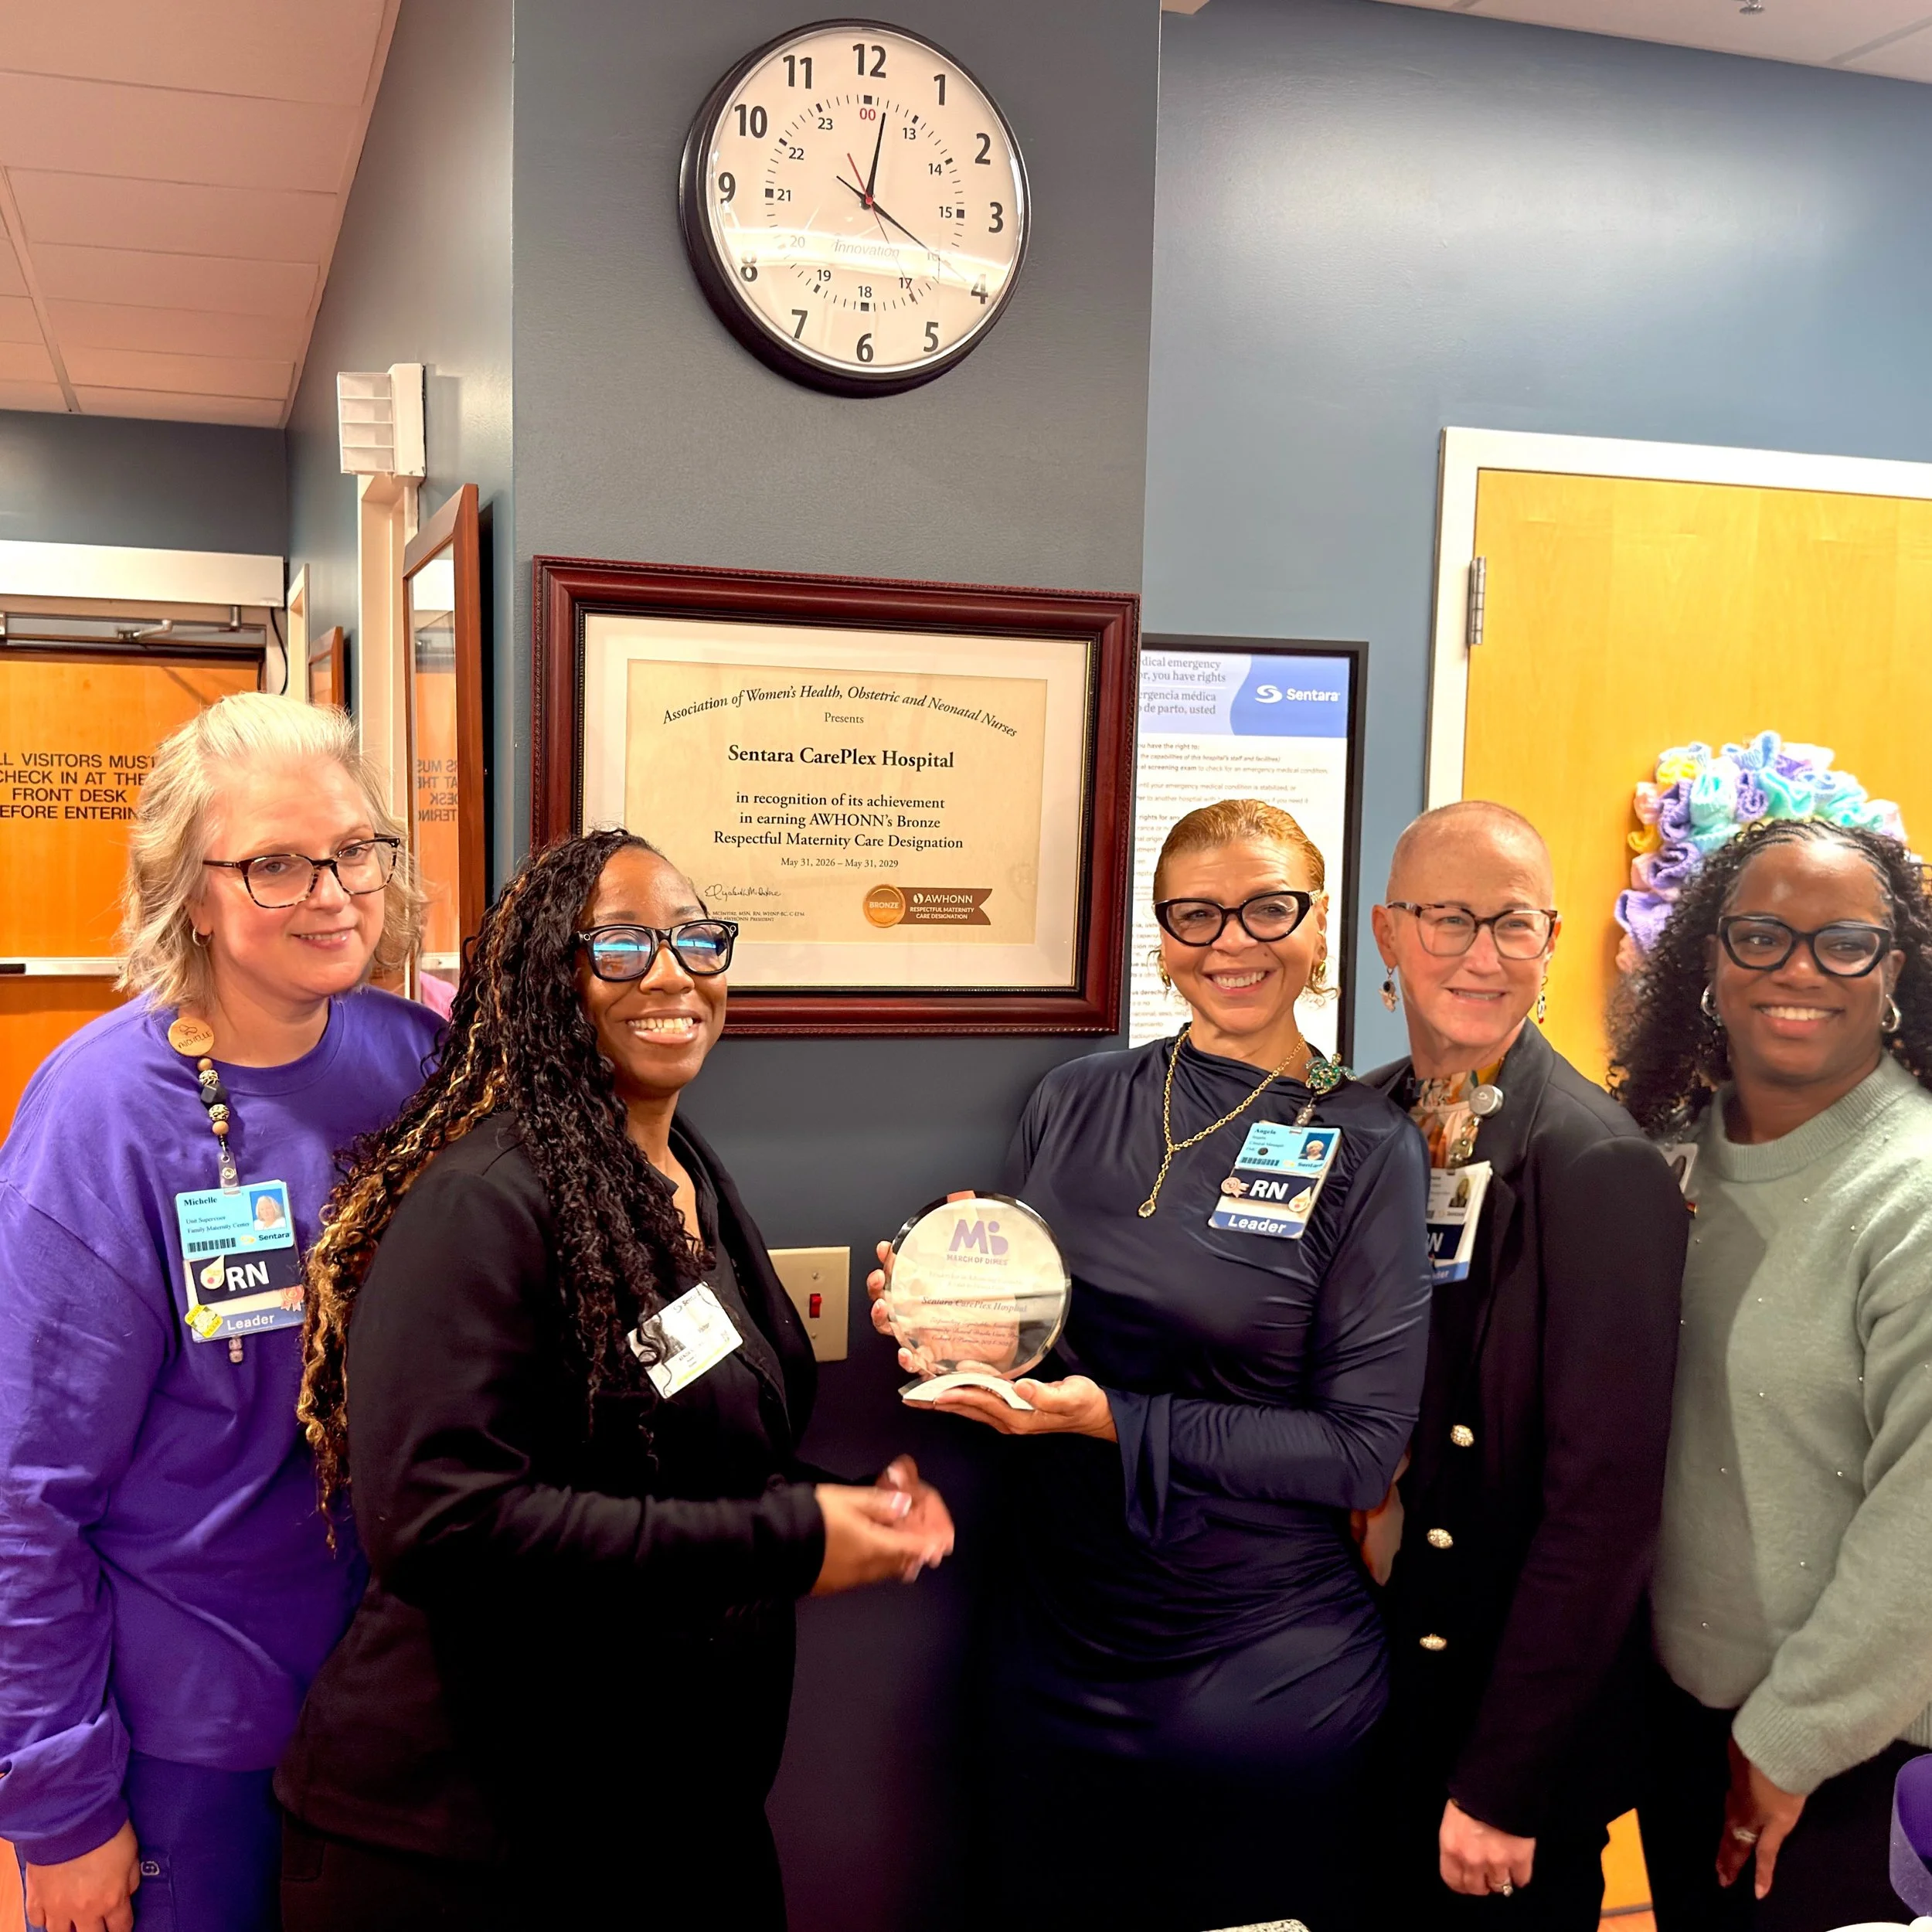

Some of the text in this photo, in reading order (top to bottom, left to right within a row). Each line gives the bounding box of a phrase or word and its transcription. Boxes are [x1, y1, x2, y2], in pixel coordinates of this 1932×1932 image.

[852, 43, 886, 78] 12
[783, 55, 812, 89] 11
[934, 74, 946, 105] 1
[734, 104, 768, 138] 10
[859, 108, 876, 121] 00
[818, 117, 833, 131] 23
[903, 128, 917, 141] 13
[788, 148, 804, 161] 22
[975, 132, 992, 165] 2
[928, 163, 942, 175] 14
[718, 172, 736, 204] 9
[777, 189, 791, 202] 21
[939, 206, 953, 219] 15
[988, 202, 1004, 233] 3
[790, 236, 806, 249] 20
[834, 240, 900, 257] Innovation
[740, 249, 758, 282] 8
[817, 269, 832, 282] 19
[899, 277, 913, 289] 17
[858, 285, 872, 298] 18
[971, 274, 988, 304] 4
[791, 309, 808, 339] 7
[923, 321, 939, 352] 5
[856, 332, 874, 362] 6
[1168, 658, 1221, 671] emergency
[1151, 672, 1170, 682] you
[1172, 671, 1196, 681] have
[1197, 672, 1226, 684] rights
[1182, 689, 1216, 702] médica
[1286, 688, 1339, 702] Sentara
[663, 697, 728, 724] Association
[731, 689, 746, 708] of
[799, 685, 842, 699] Health,
[848, 685, 900, 702] Obstetric
[902, 695, 927, 707] and
[927, 696, 982, 722] Neonatal
[981, 712, 1018, 737] Nurses
[1144, 702, 1156, 713] de
[1158, 703, 1187, 716] parto,
[1189, 704, 1216, 715] usted
[825, 712, 864, 724] Presents
[1175, 743, 1189, 751] right
[22, 753, 103, 768] VISITORS
[109, 755, 155, 770] MUST
[728, 744, 954, 772] Sentara CarePlex Hospital
[61, 771, 78, 784] IN
[85, 771, 107, 785] AT
[114, 772, 149, 786] THE
[12, 787, 128, 803] FRONT DESK
[736, 791, 945, 808] in recognition of its achievement
[0, 804, 58, 819] EFORE
[740, 812, 753, 824] in
[757, 814, 806, 828] earning
[897, 815, 940, 828] Bronze
[714, 831, 963, 852] Respectful Maternity Care Designation
[781, 858, 798, 868] May
[800, 859, 813, 867] 31,
[845, 859, 862, 869] May
[864, 859, 876, 869] 31,
[879, 859, 899, 868] 2029
[923, 894, 973, 903] AWHONN
[1250, 1179, 1290, 1200] RN
[184, 1196, 217, 1206] Michelle
[198, 1215, 226, 1223] Supervisor
[1227, 1214, 1287, 1234] Leader
[206, 1223, 231, 1233] Maternity
[258, 1232, 291, 1241] Sentara
[946, 1253, 974, 1263] MARCH
[985, 1257, 1009, 1266] DIMES
[226, 1260, 270, 1291] RN
[226, 1314, 275, 1332] Leader
